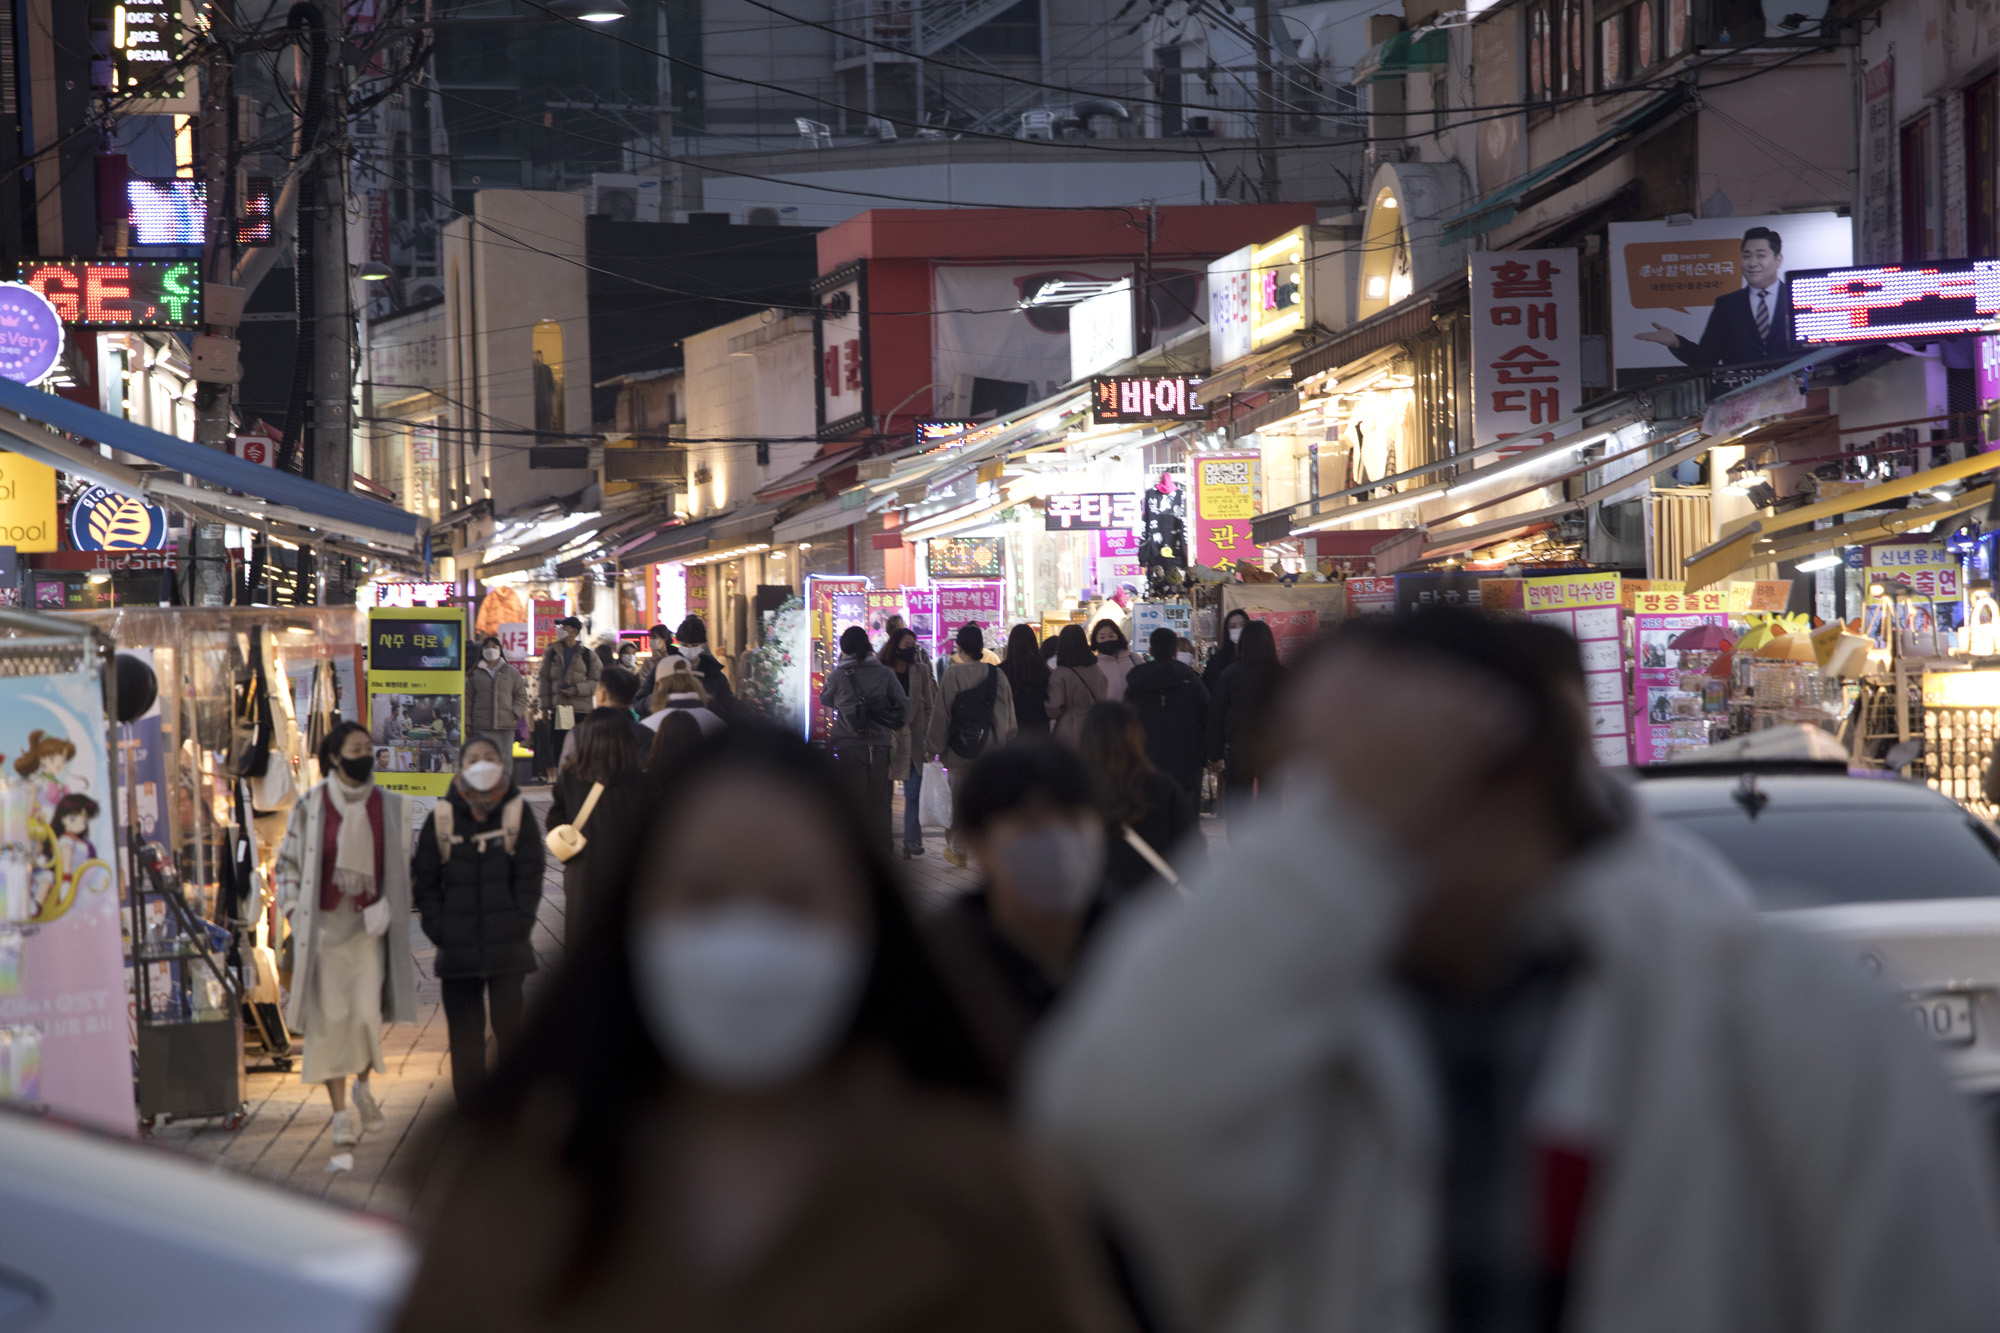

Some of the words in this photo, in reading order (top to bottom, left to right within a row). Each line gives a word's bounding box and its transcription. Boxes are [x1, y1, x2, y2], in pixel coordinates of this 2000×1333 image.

[1880, 549, 1946, 566] 신년운세
[942, 591, 996, 607] 깜짝세일
[1527, 584, 1565, 605] 연예인
[1567, 580, 1617, 602] 다수상담
[1644, 594, 1720, 611] 방송출연
[379, 633, 405, 649] 사주
[413, 634, 439, 649] 타로
